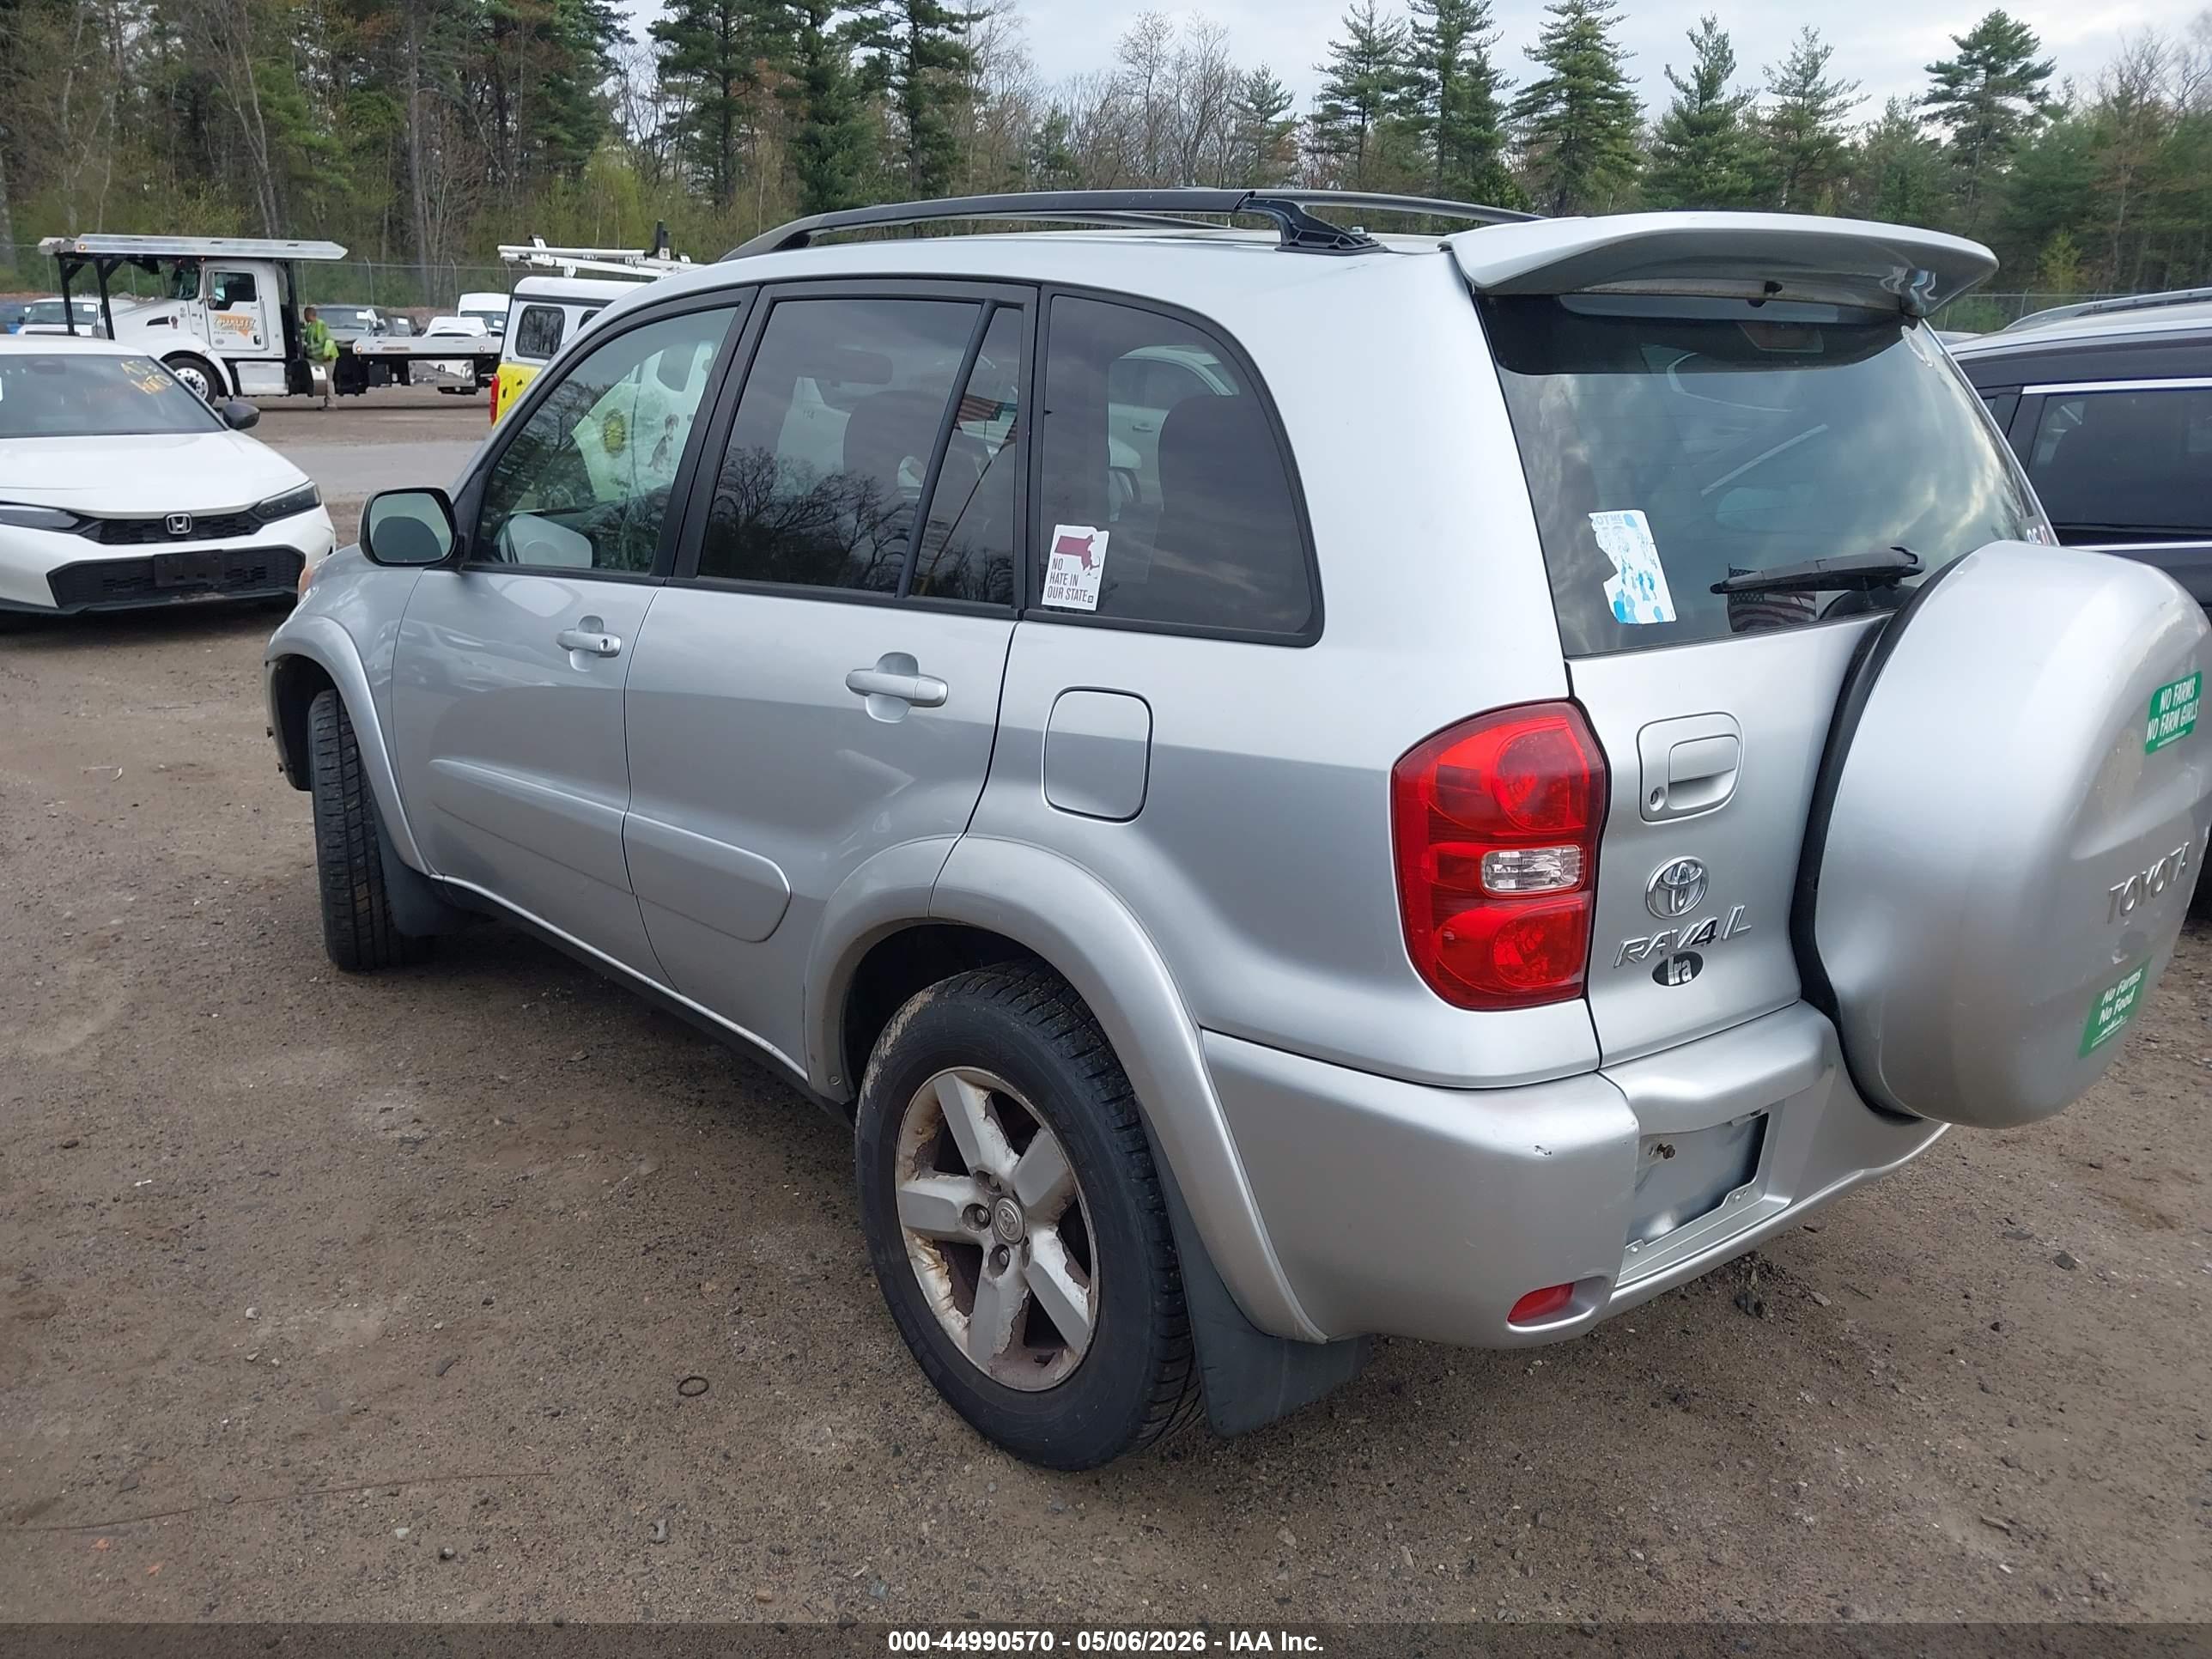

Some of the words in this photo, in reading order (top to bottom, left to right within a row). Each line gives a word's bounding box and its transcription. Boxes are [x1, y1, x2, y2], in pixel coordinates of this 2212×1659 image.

[1049, 572, 1069, 586] HATE
[1069, 574, 1079, 587] IN
[1051, 557, 1064, 571] NO
[1047, 586, 1064, 599] OUR
[1065, 587, 1089, 602] STATE
[2159, 687, 2172, 714] NO
[2172, 677, 2197, 708] FARMS
[2146, 717, 2160, 744] NO
[2159, 708, 2181, 737] FARM
[2180, 699, 2199, 727] GIRLS
[2107, 842, 2190, 925] TOYOTA
[1613, 916, 1718, 969] RAV4
[1667, 955, 1693, 986] Ira
